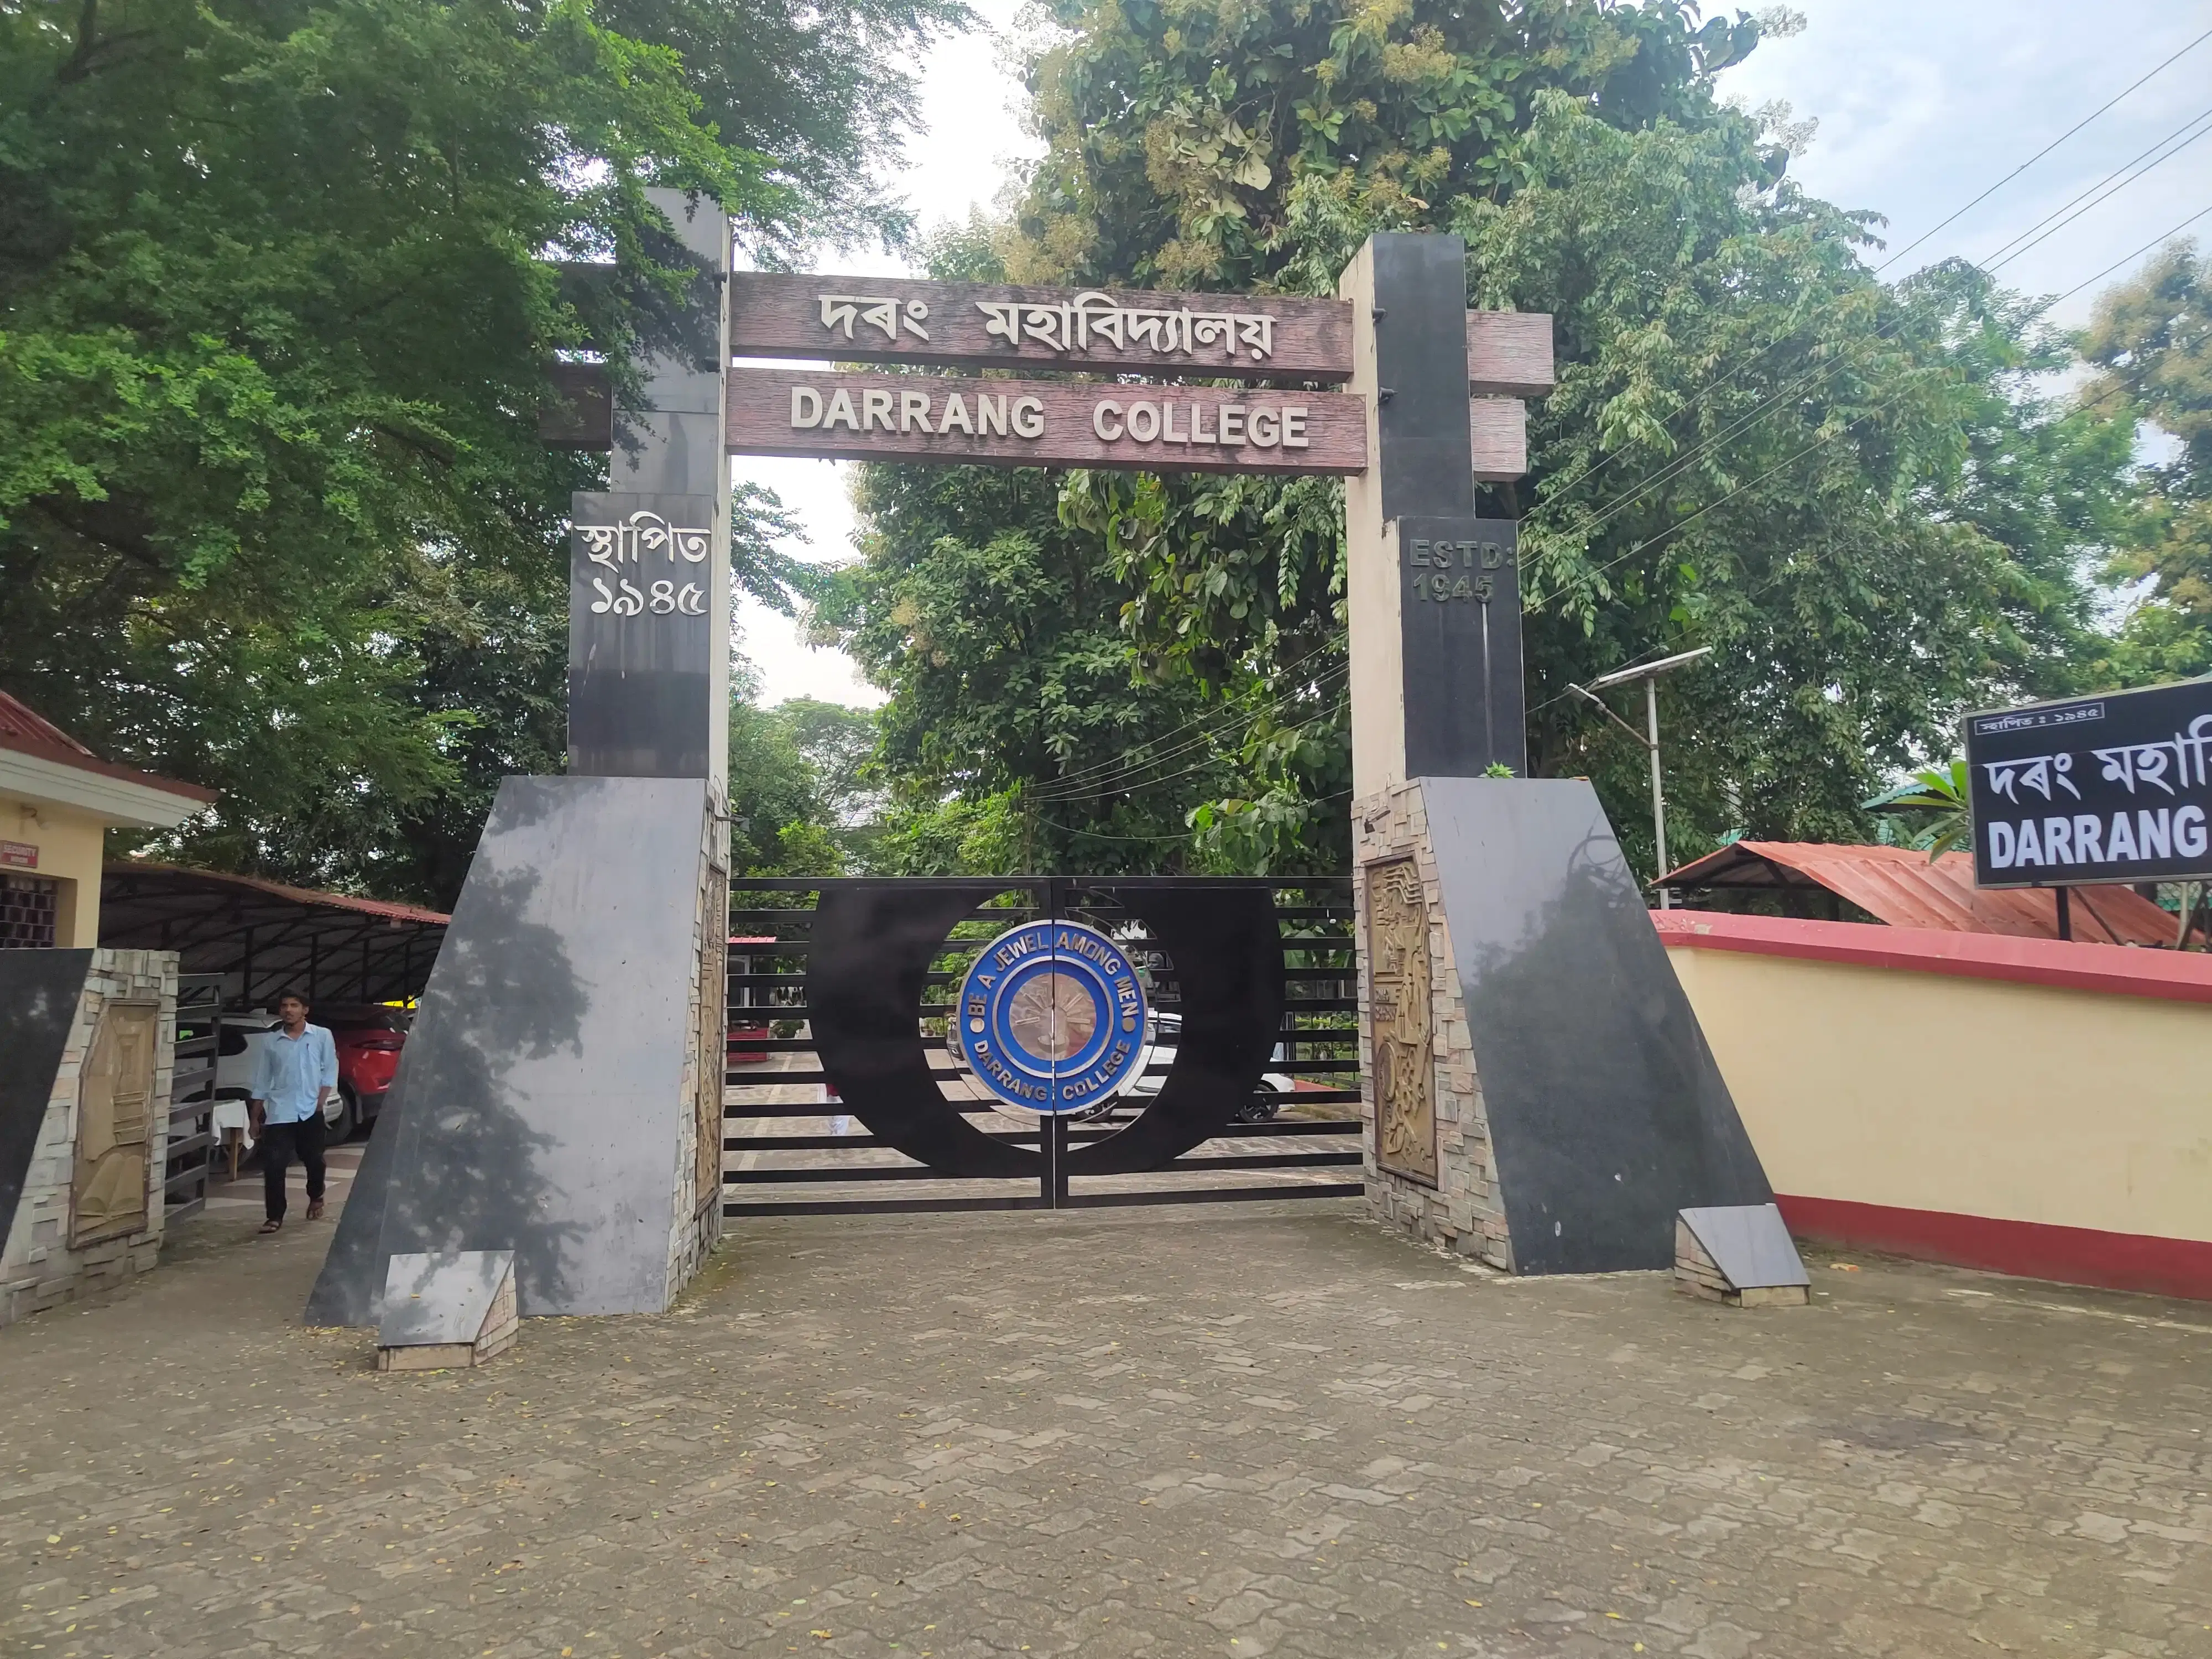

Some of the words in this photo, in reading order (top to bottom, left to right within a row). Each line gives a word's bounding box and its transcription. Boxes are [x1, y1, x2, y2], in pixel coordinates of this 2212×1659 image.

[818, 295, 929, 341] দৰং
[975, 291, 1277, 361] মহাবিদ্যালয়
[791, 387, 1045, 438] DARRANG
[1093, 399, 1310, 447] COLLEGE
[574, 511, 712, 573] স্থাপিত
[1410, 539, 1515, 570] ESTD:
[591, 577, 708, 616] ১৯৪৫
[1413, 573, 1493, 603] 1945
[2054, 708, 2099, 722] ১৯৪৫
[1983, 753, 2081, 805] দৰং
[1988, 805, 2208, 868] DARRANG
[967, 993, 987, 1016] BE
[977, 974, 997, 990] A
[993, 932, 1049, 972] JEWEL
[1055, 931, 1121, 975] AMONG
[1114, 975, 1139, 1016] MEN
[974, 1039, 1048, 1101] DARRANG
[1062, 1040, 1131, 1101] COLLEGE
